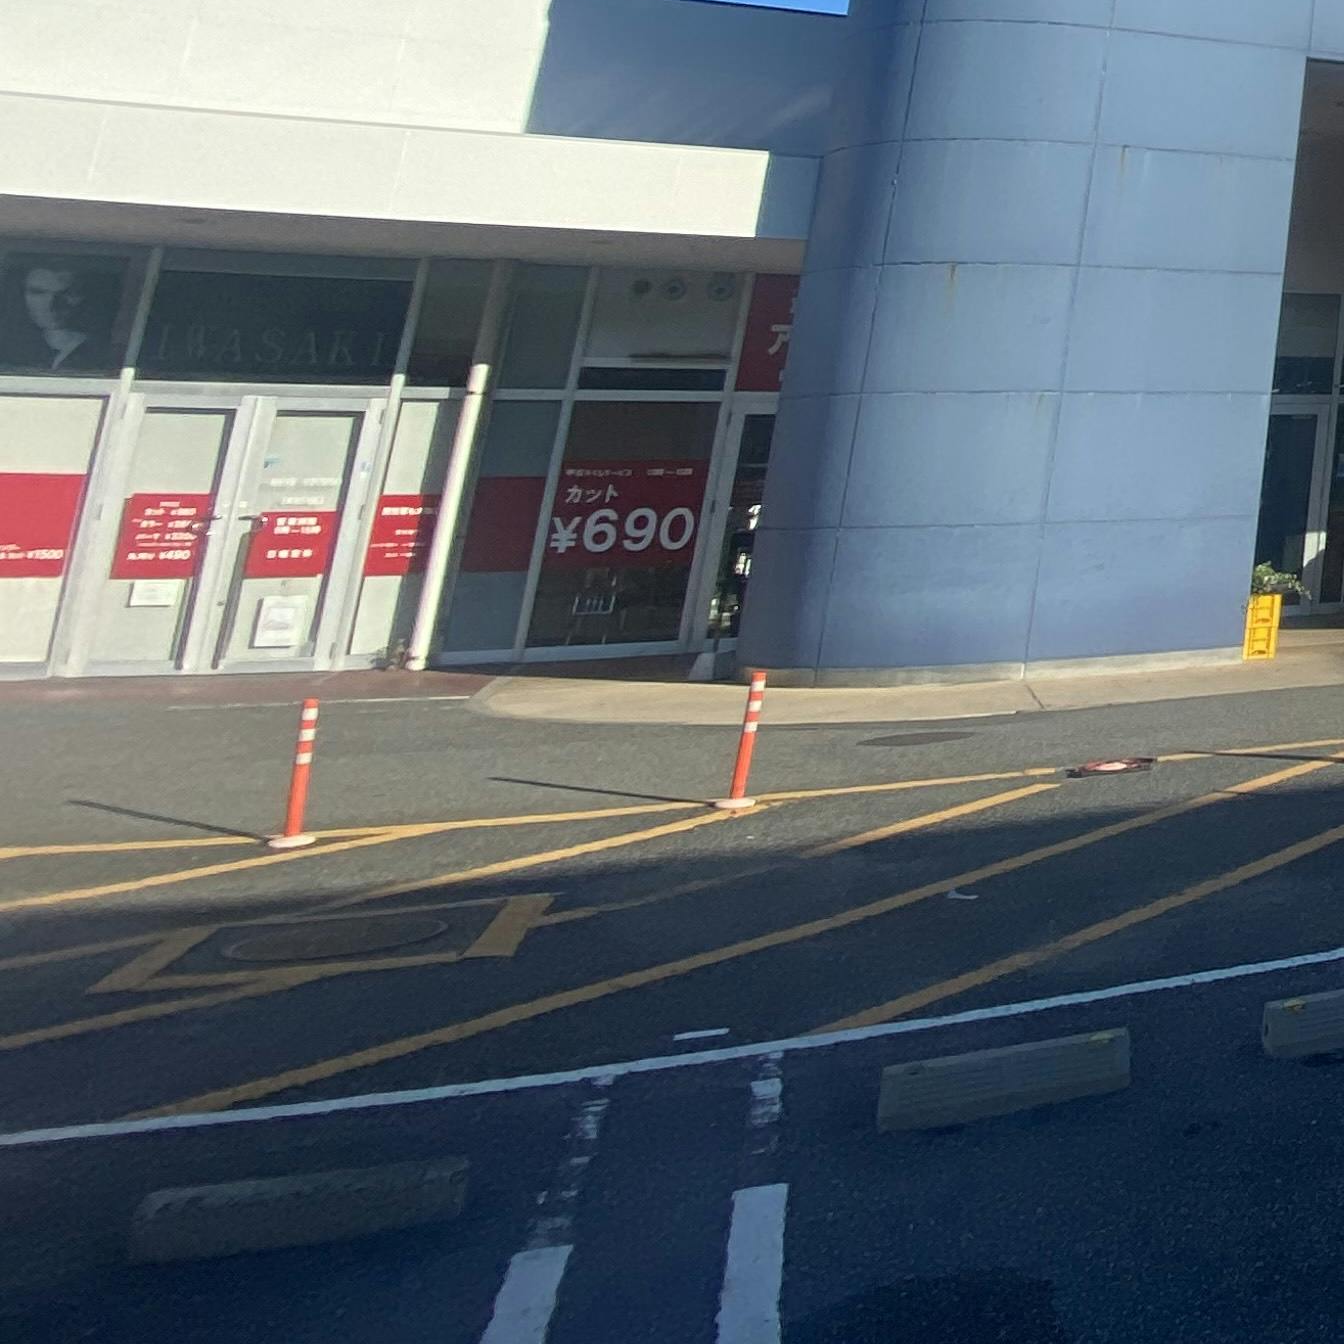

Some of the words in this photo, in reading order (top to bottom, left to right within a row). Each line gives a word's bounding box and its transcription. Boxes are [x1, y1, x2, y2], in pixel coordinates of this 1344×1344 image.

[565, 484, 619, 504] カット
[551, 507, 695, 553] ¥690
